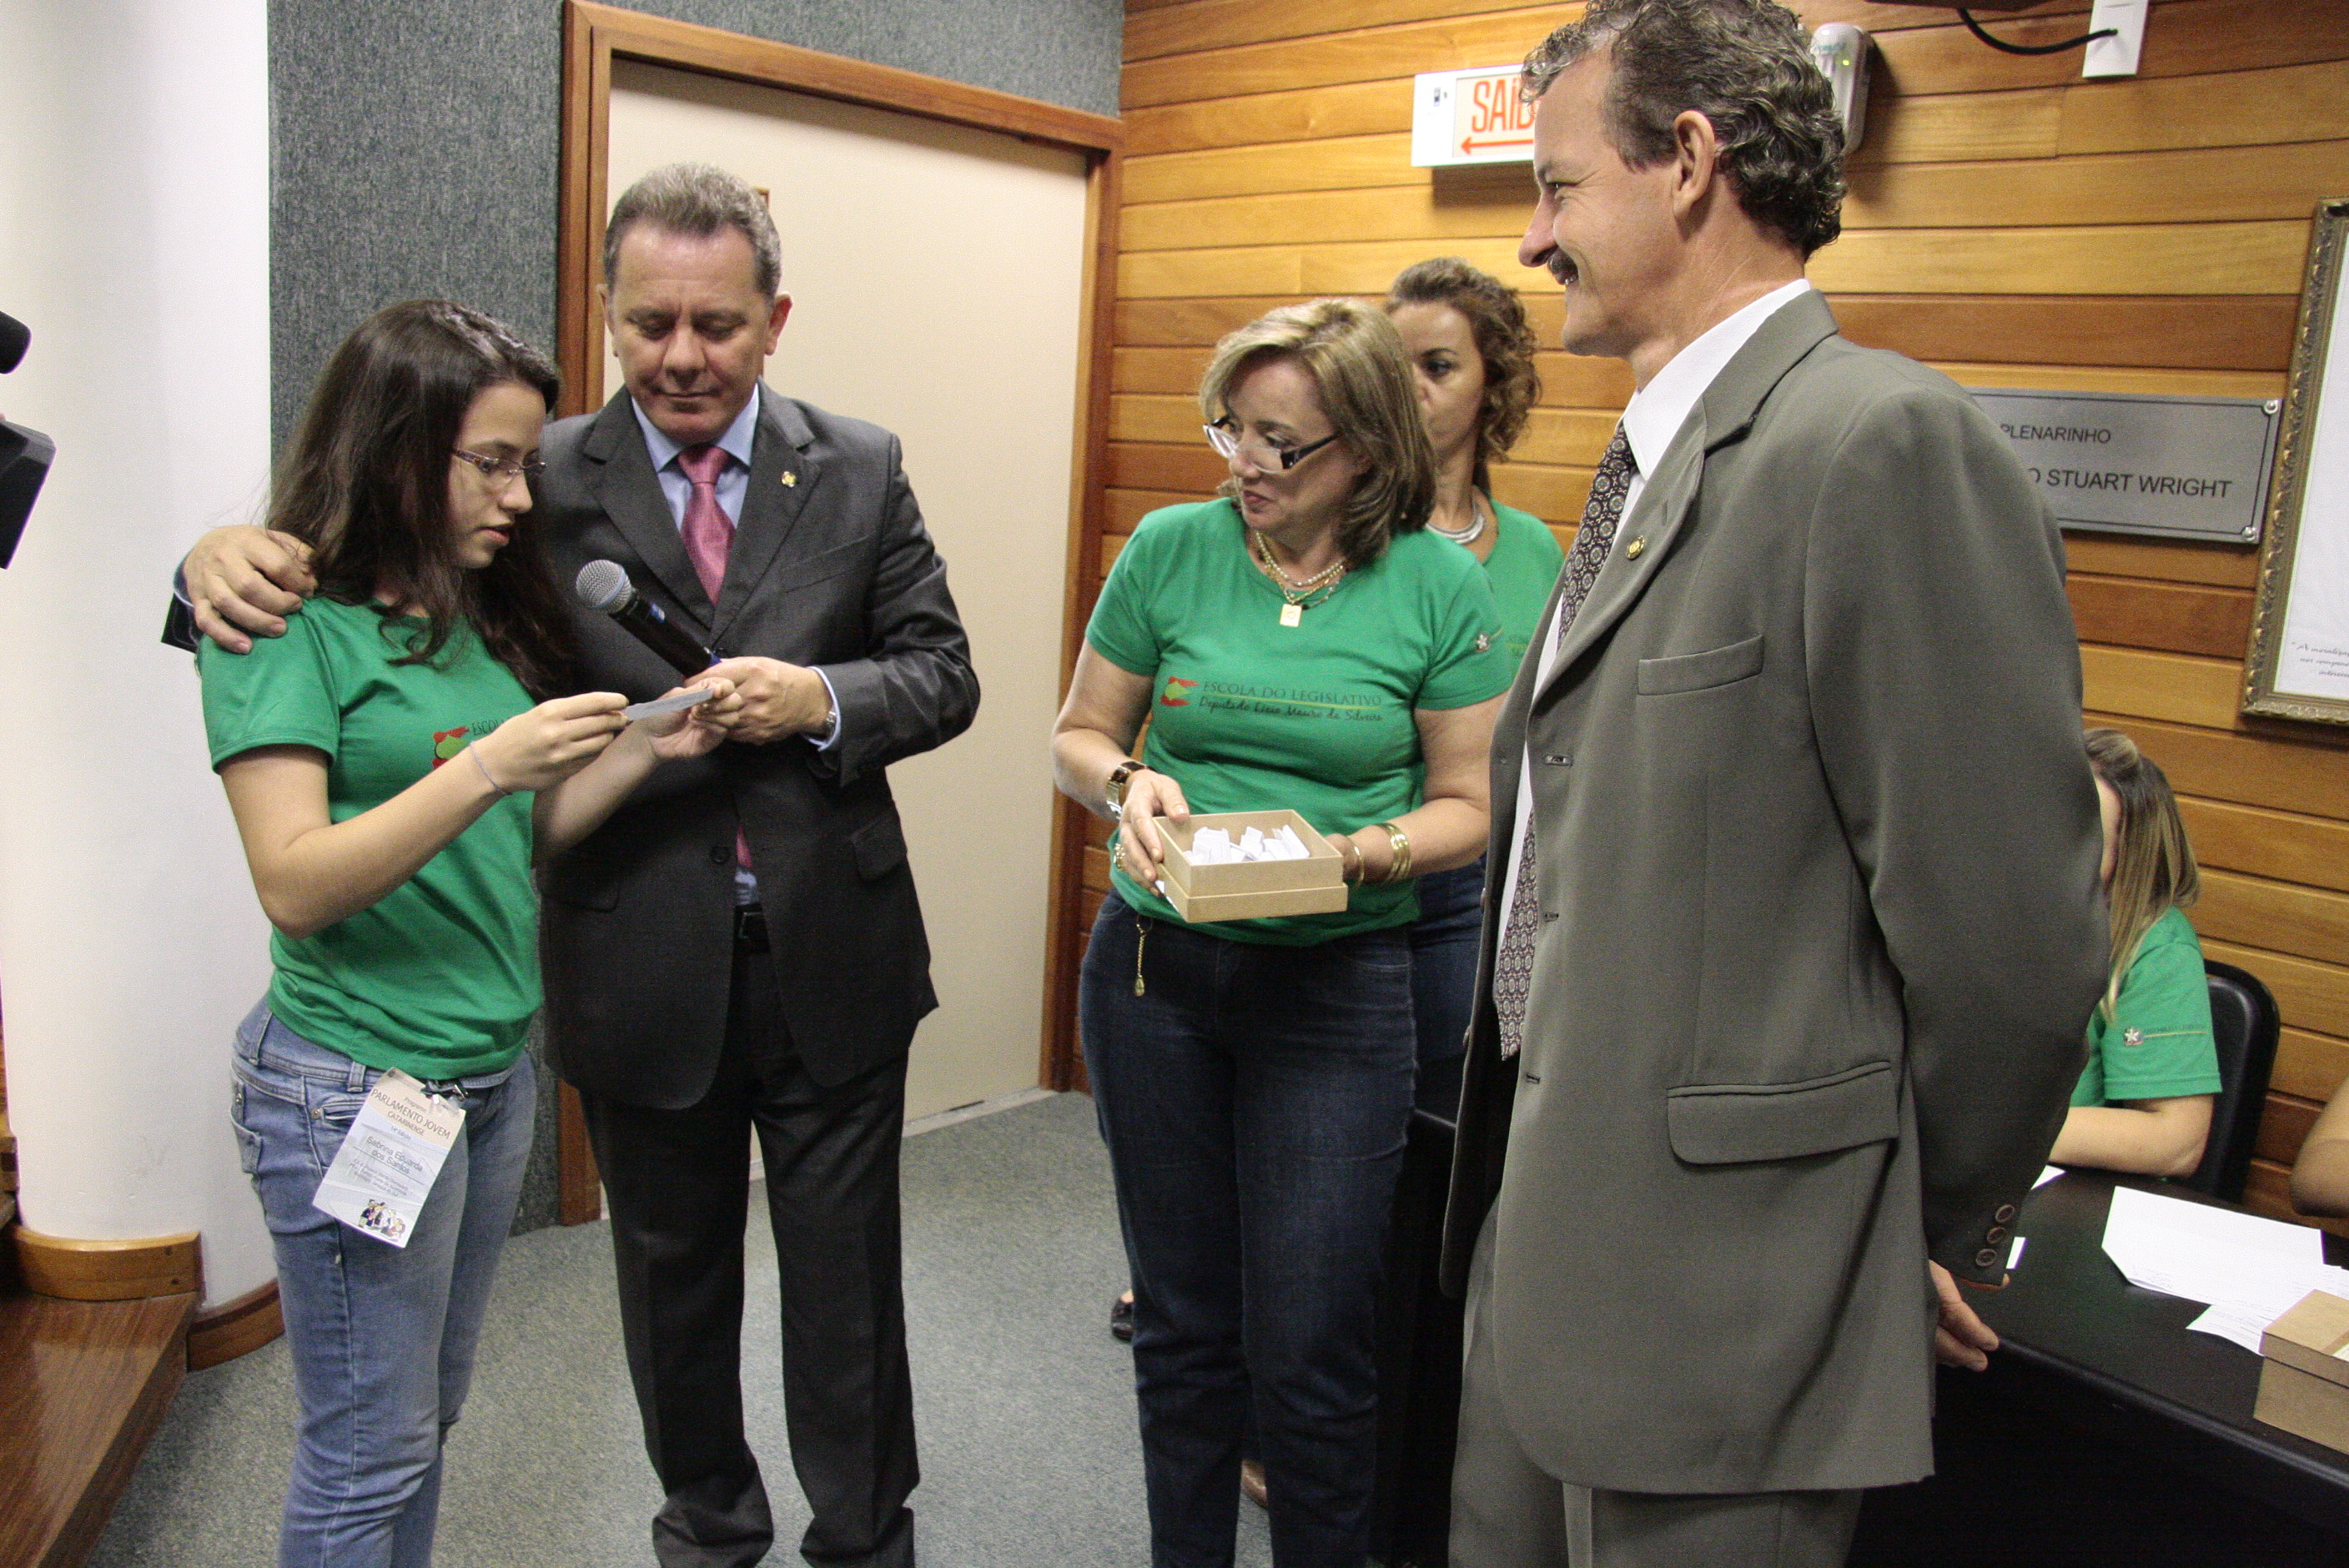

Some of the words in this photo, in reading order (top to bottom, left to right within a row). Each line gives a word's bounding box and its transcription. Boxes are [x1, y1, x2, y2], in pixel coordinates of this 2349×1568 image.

[2046, 468, 2135, 492] STUART
[2139, 475, 2233, 498] WRIGHT
[1203, 681, 1256, 697] ESCOLA
[1261, 685, 1287, 698] DO
[1291, 688, 1382, 706] LEGISLATIVO
[370, 1088, 424, 1123] PARLAMENTO
[424, 1118, 451, 1139] JOVEM
[387, 1110, 425, 1136] CATARINENSE
[366, 1136, 395, 1155] Sabrina
[395, 1150, 424, 1172] Eduarda
[372, 1148, 385, 1161] dos
[386, 1156, 410, 1174] Santos
